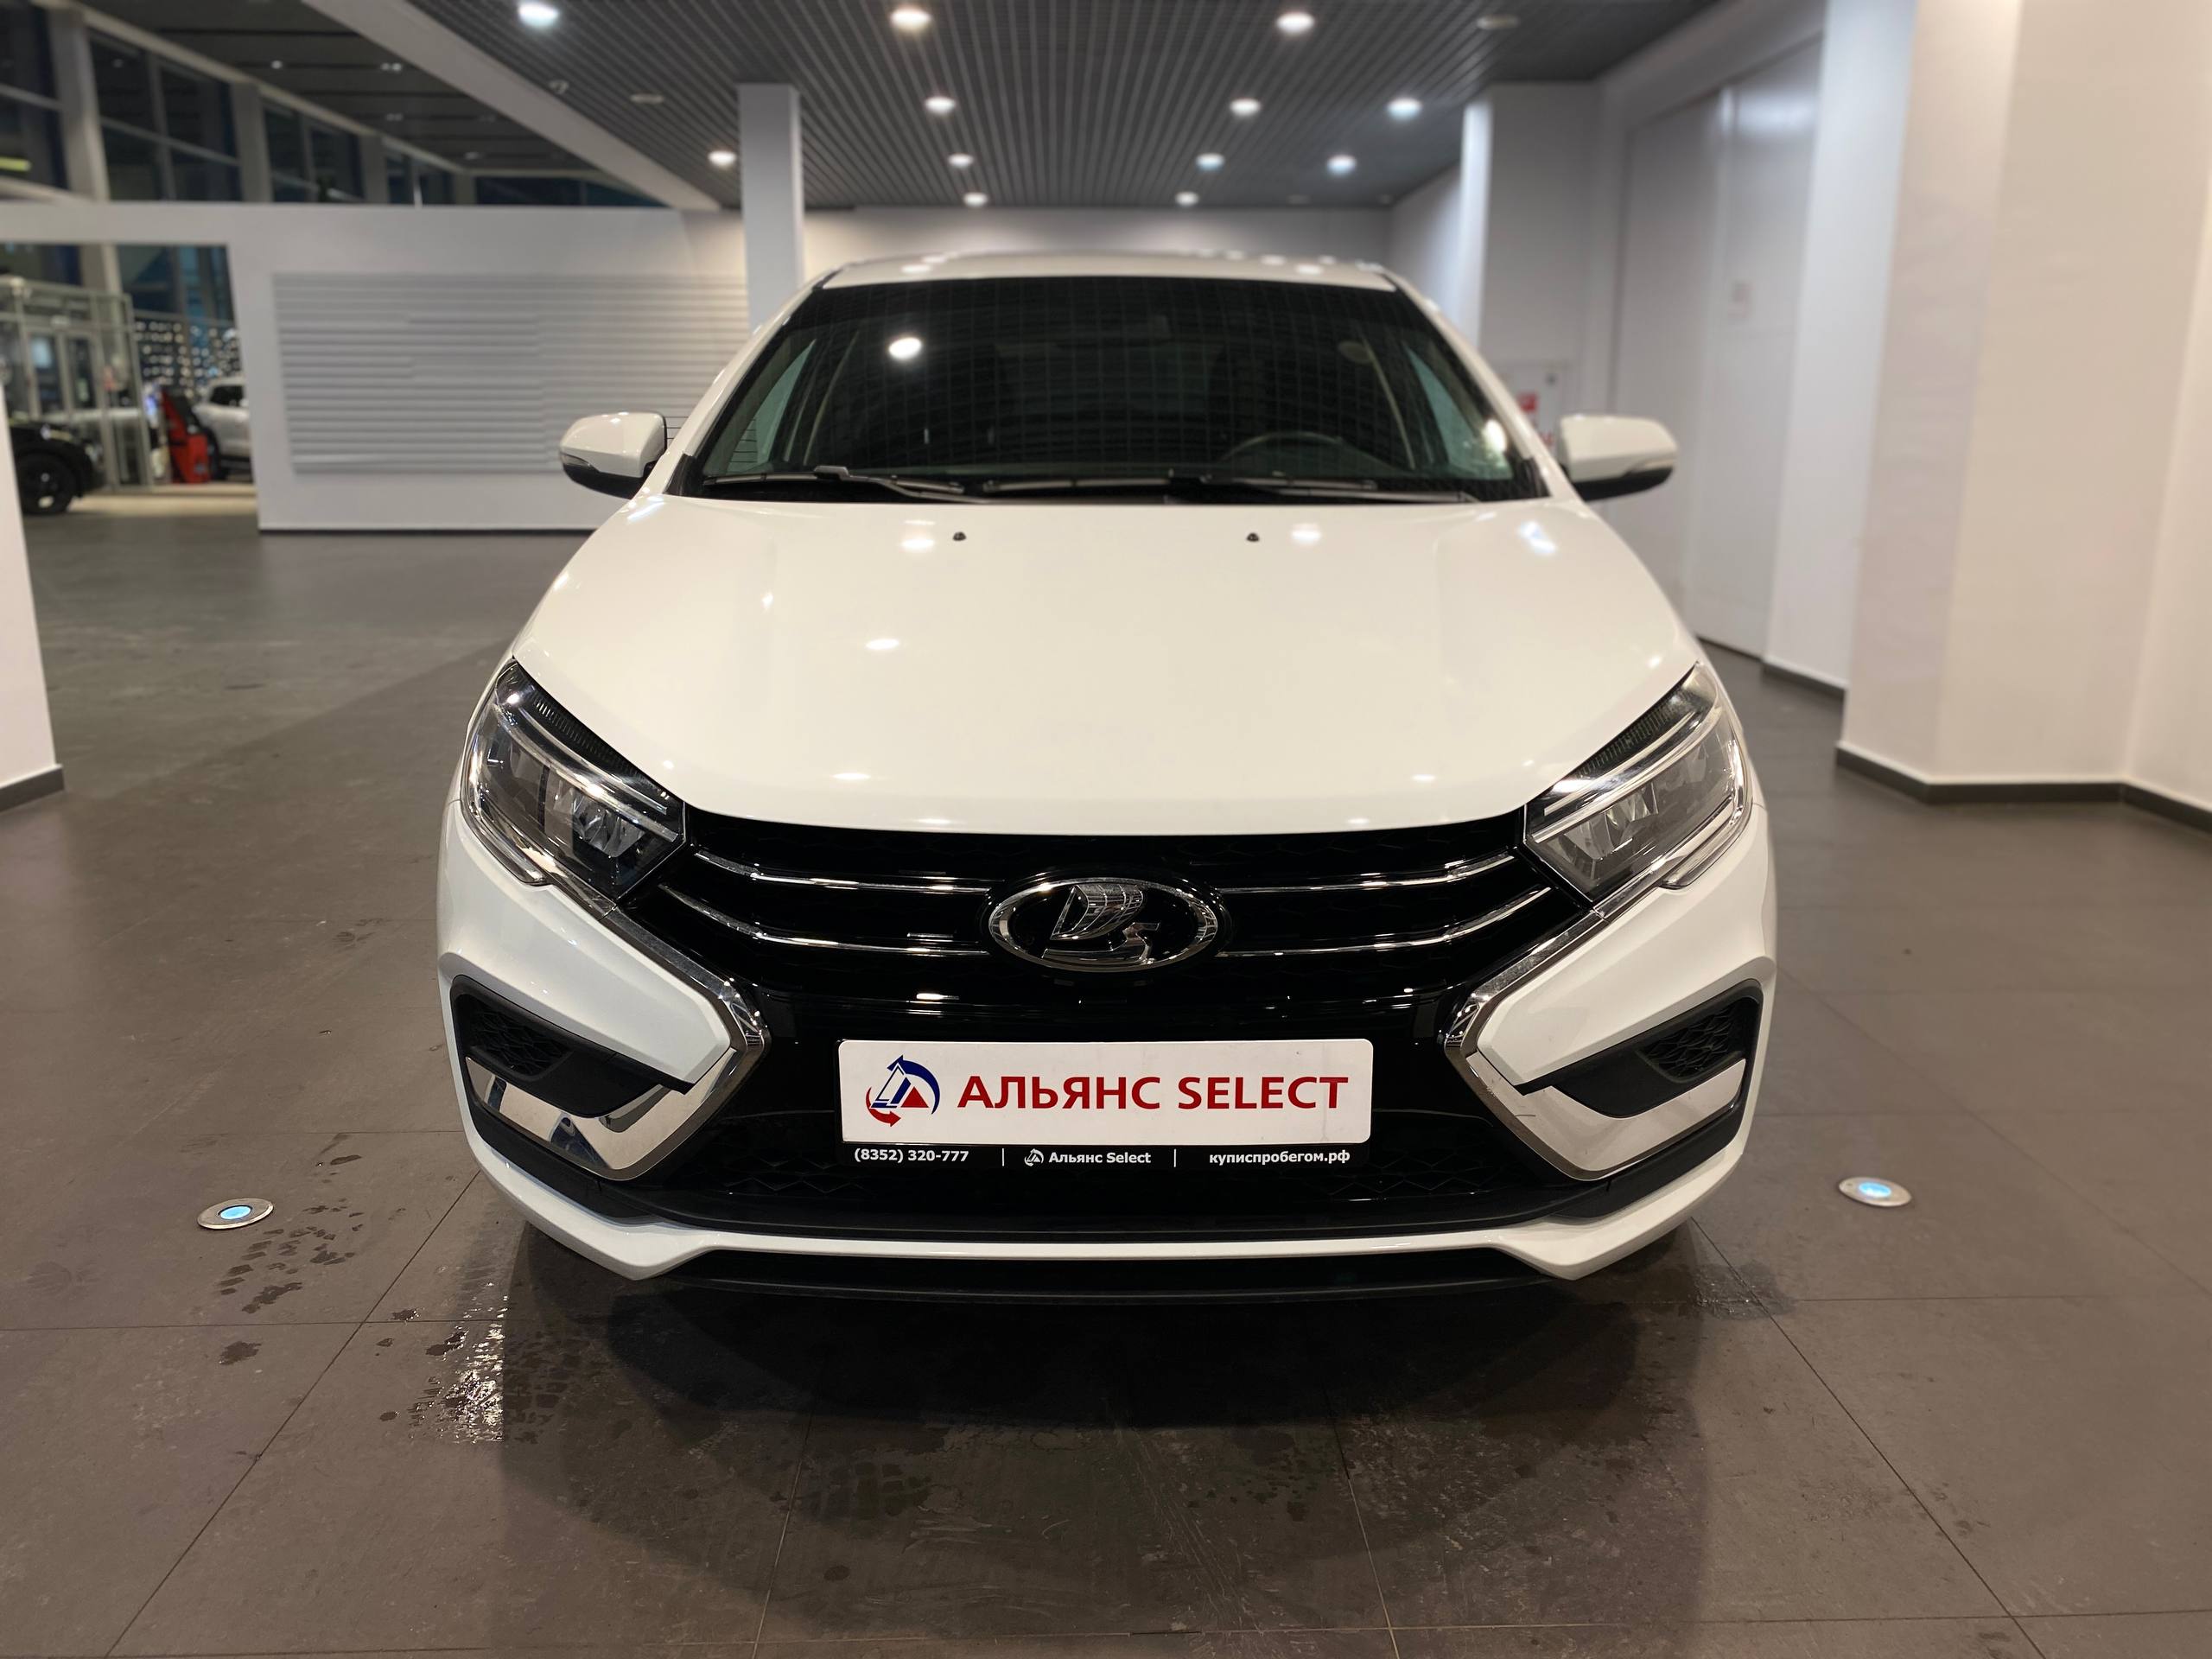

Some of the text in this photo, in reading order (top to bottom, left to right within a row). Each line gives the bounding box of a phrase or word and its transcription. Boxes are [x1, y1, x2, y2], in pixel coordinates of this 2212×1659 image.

[957, 1074, 1350, 1111] АЛЬЯНС SELECT
[854, 1147, 969, 1164] (8352) 320-777
[1048, 1151, 1152, 1164] Альянс Select
[1209, 1149, 1351, 1166] куписпробегом.рф
